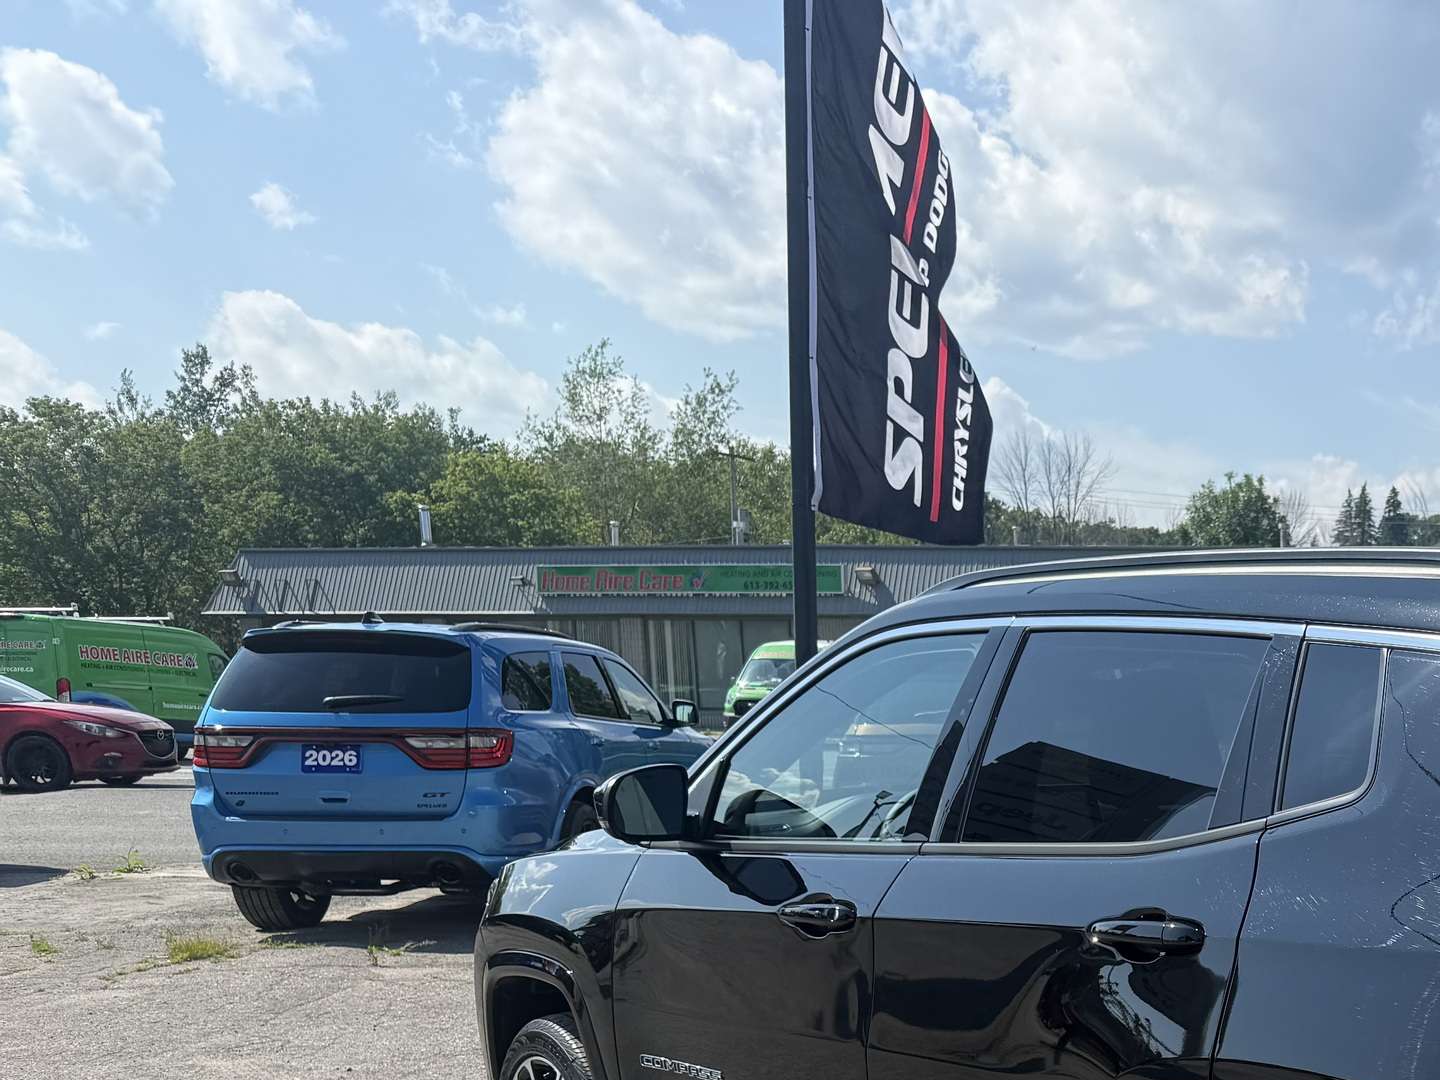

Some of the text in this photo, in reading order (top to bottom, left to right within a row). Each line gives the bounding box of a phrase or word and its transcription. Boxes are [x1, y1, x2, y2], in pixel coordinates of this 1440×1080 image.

[923, 150, 950, 254] DODG
[952, 353, 975, 512] CHRYSLE
[541, 568, 683, 591] Home Aire Care
[79, 645, 182, 667] HOME AIRE CARE
[303, 750, 358, 767] 2026
